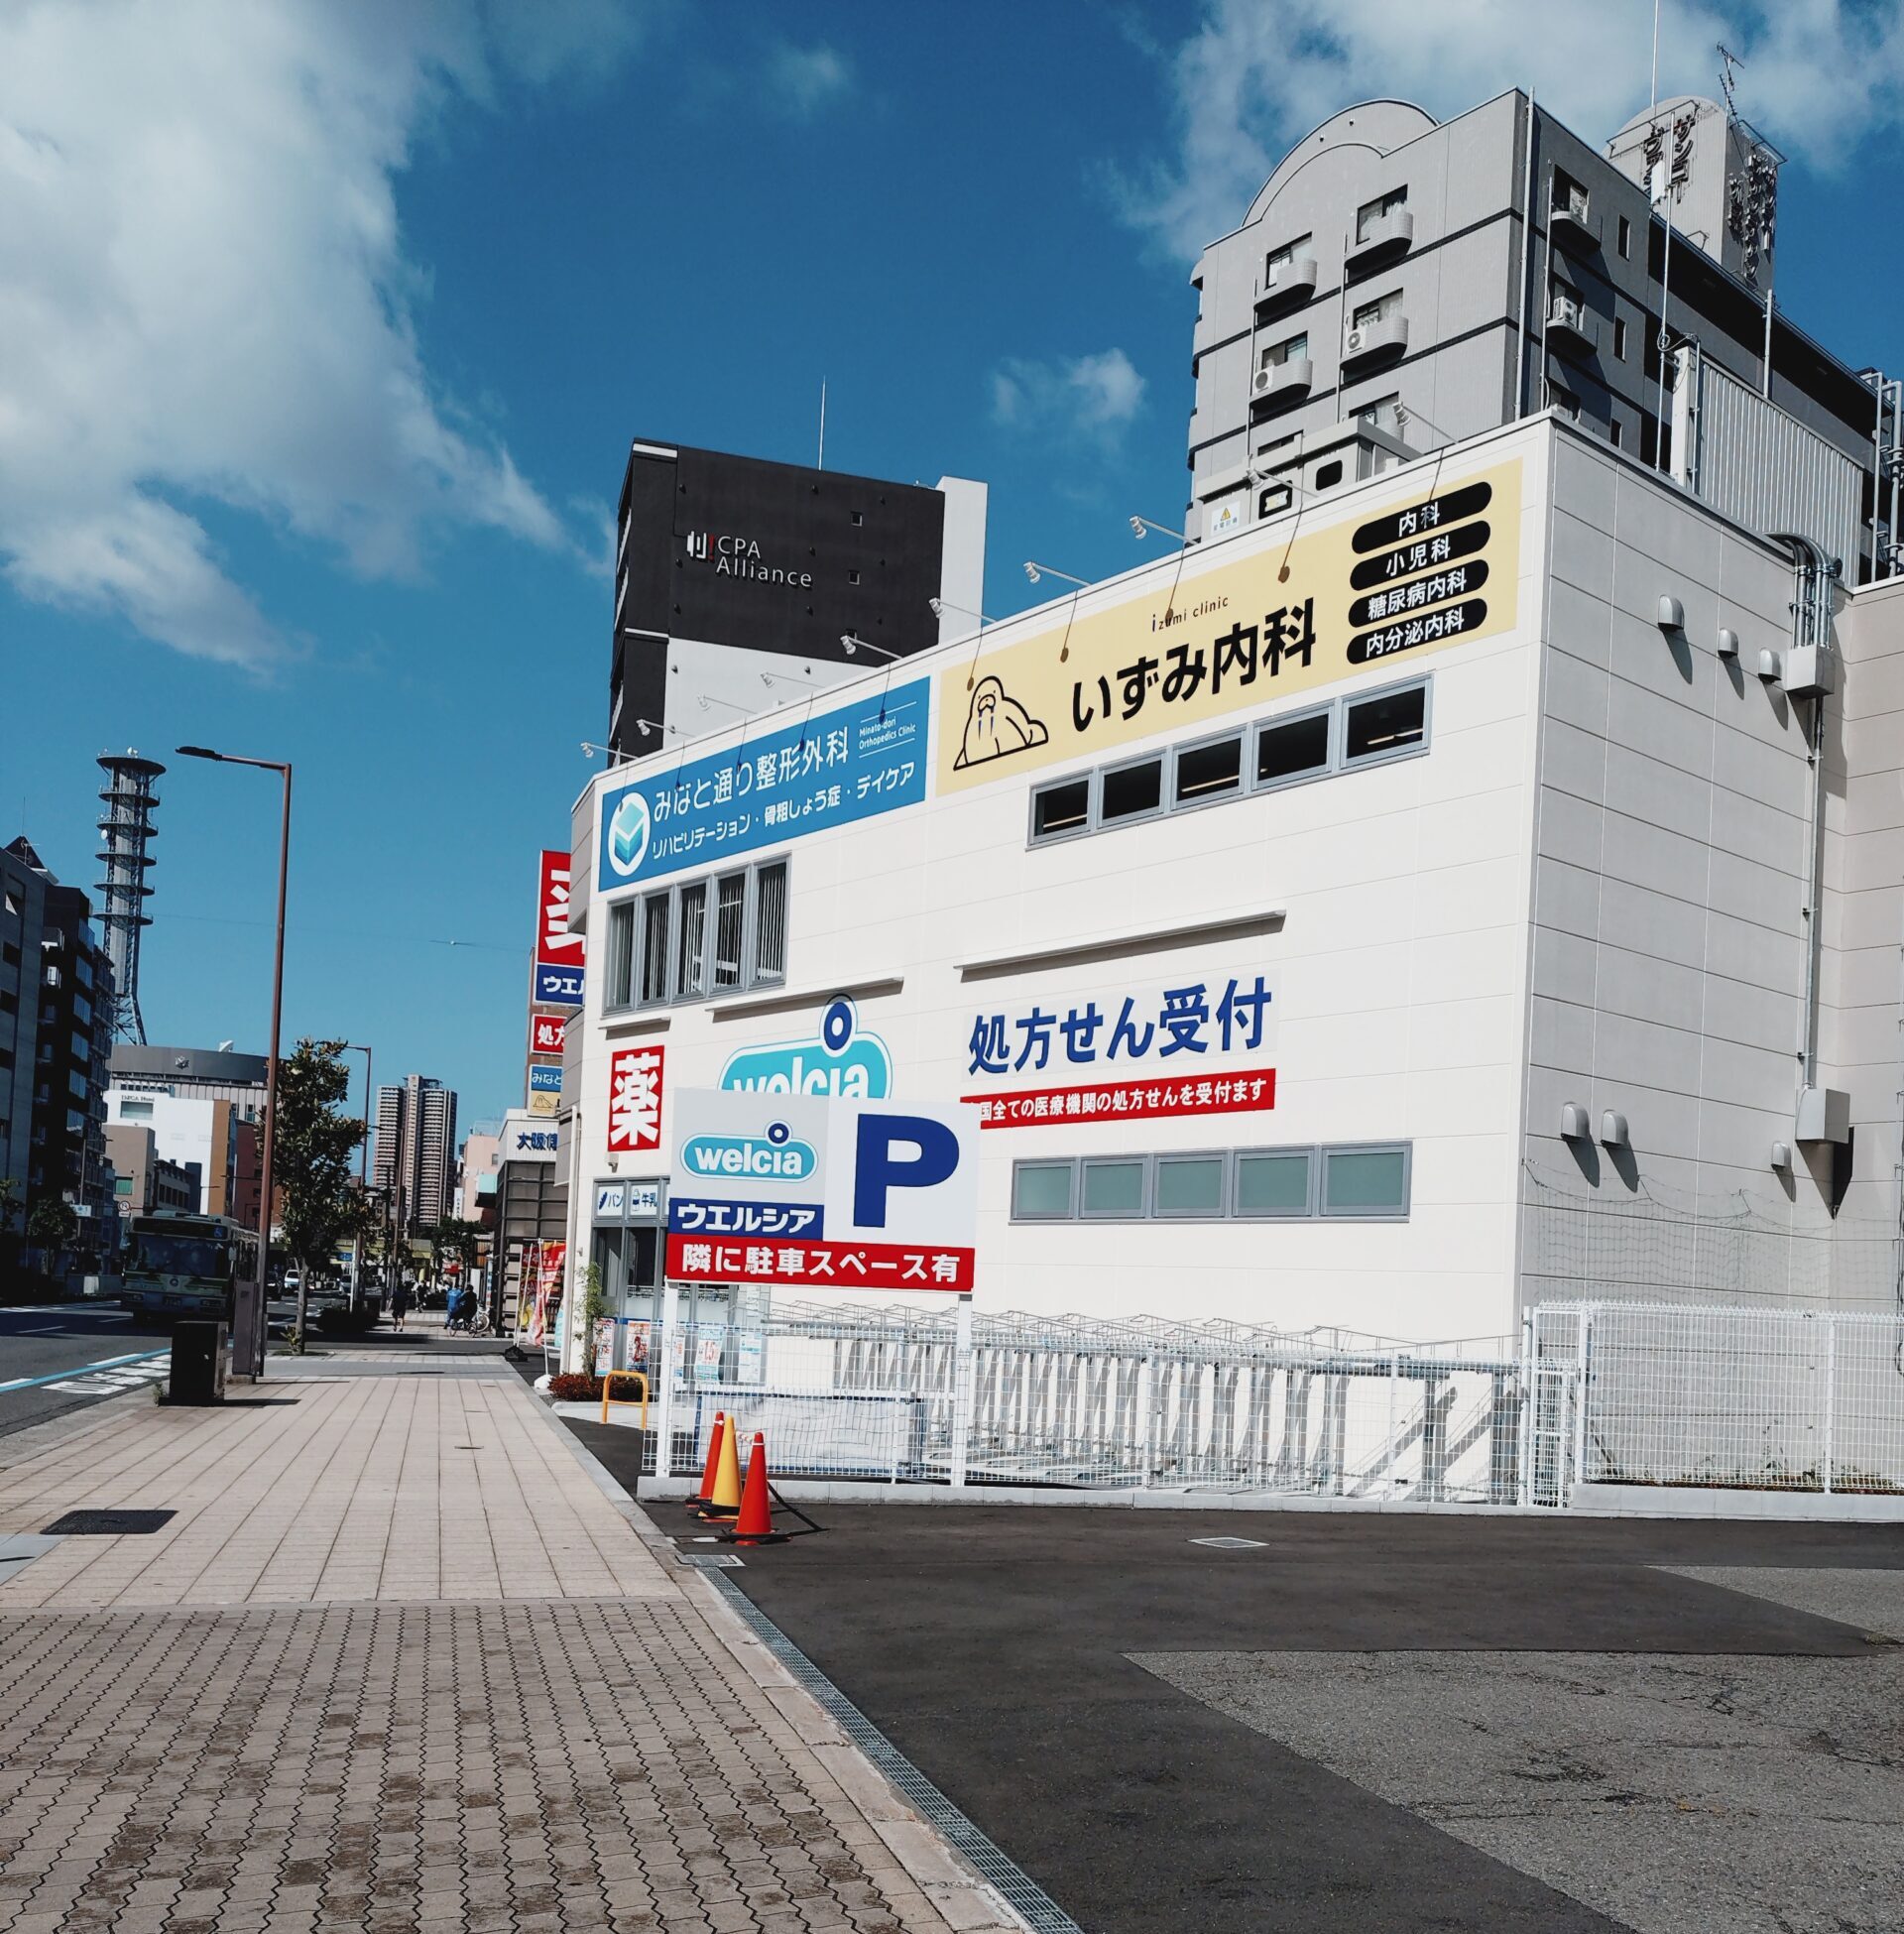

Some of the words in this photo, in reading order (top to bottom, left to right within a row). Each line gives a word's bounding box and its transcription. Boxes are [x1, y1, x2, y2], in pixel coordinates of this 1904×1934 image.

[1398, 502, 1441, 538] 内科
[717, 536, 761, 559] CPA
[1385, 536, 1452, 577] 小児科
[716, 556, 812, 587] Alliance
[1368, 567, 1468, 621] 糖尿病内科
[1152, 607, 1187, 632] izumi
[1193, 596, 1229, 617] clinic
[1366, 607, 1466, 659] 内分泌内科
[1072, 597, 1316, 732] いずみ内科
[859, 715, 896, 738] Minato-dori
[859, 730, 897, 750] Orthopedics
[897, 723, 916, 737] Clinic
[654, 726, 849, 823] みなと通り整形外科
[967, 976, 1272, 1077] 処方せん受付
[609, 1050, 661, 1147] 薬
[694, 1142, 802, 1176] welcia
[853, 1113, 960, 1229] P
[608, 1192, 624, 1208] パン
[677, 1202, 816, 1234] ウエルシア
[681, 1243, 961, 1283] 隣に駐車スペース有
